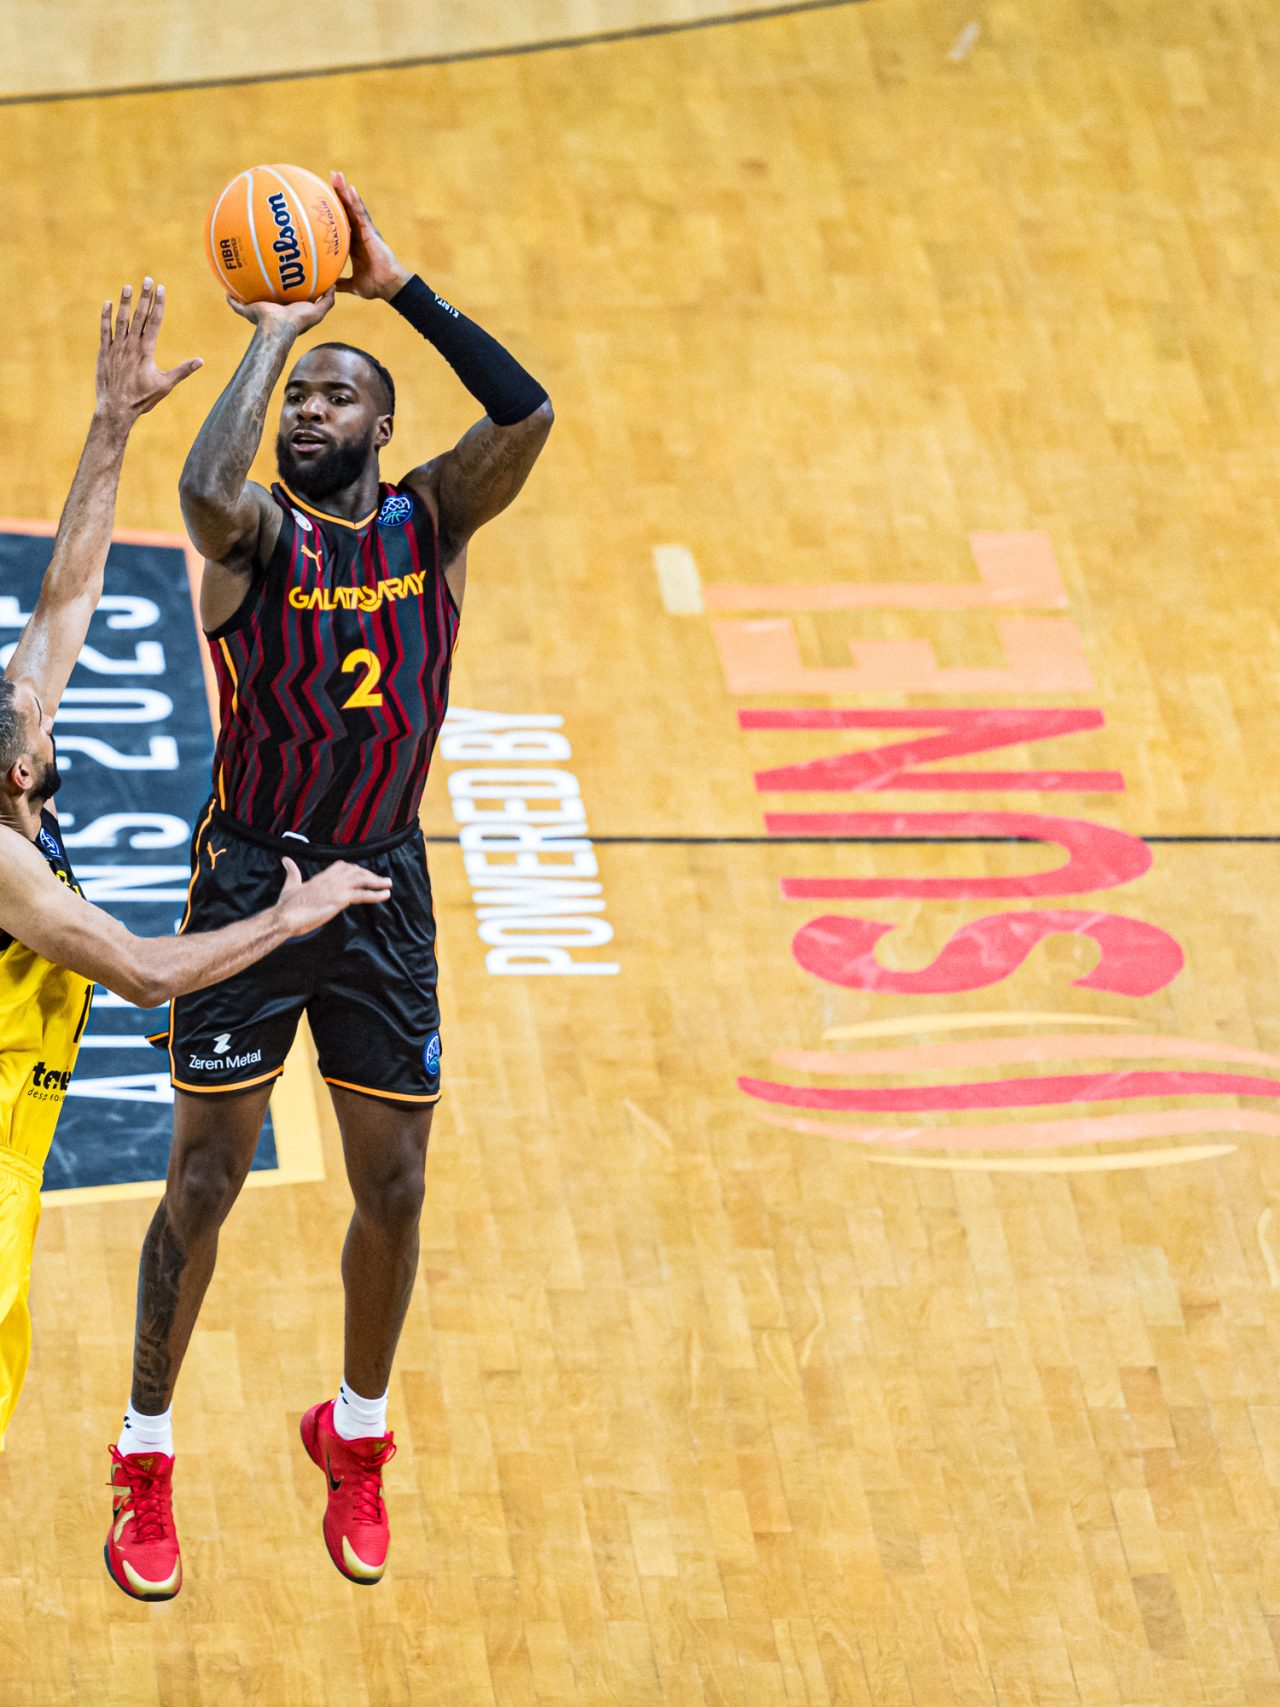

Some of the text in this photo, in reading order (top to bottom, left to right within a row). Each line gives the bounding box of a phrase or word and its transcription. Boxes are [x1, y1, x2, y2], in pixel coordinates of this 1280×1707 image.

[220, 238, 238, 270] FIBA
[267, 191, 307, 292] Wilson
[288, 569, 426, 613] GALATASARAY
[341, 648, 383, 709] 2
[702, 530, 1186, 997] SUNEL
[440, 705, 620, 975] POWERED BY
[189, 1049, 262, 1070] Zeren Metal
